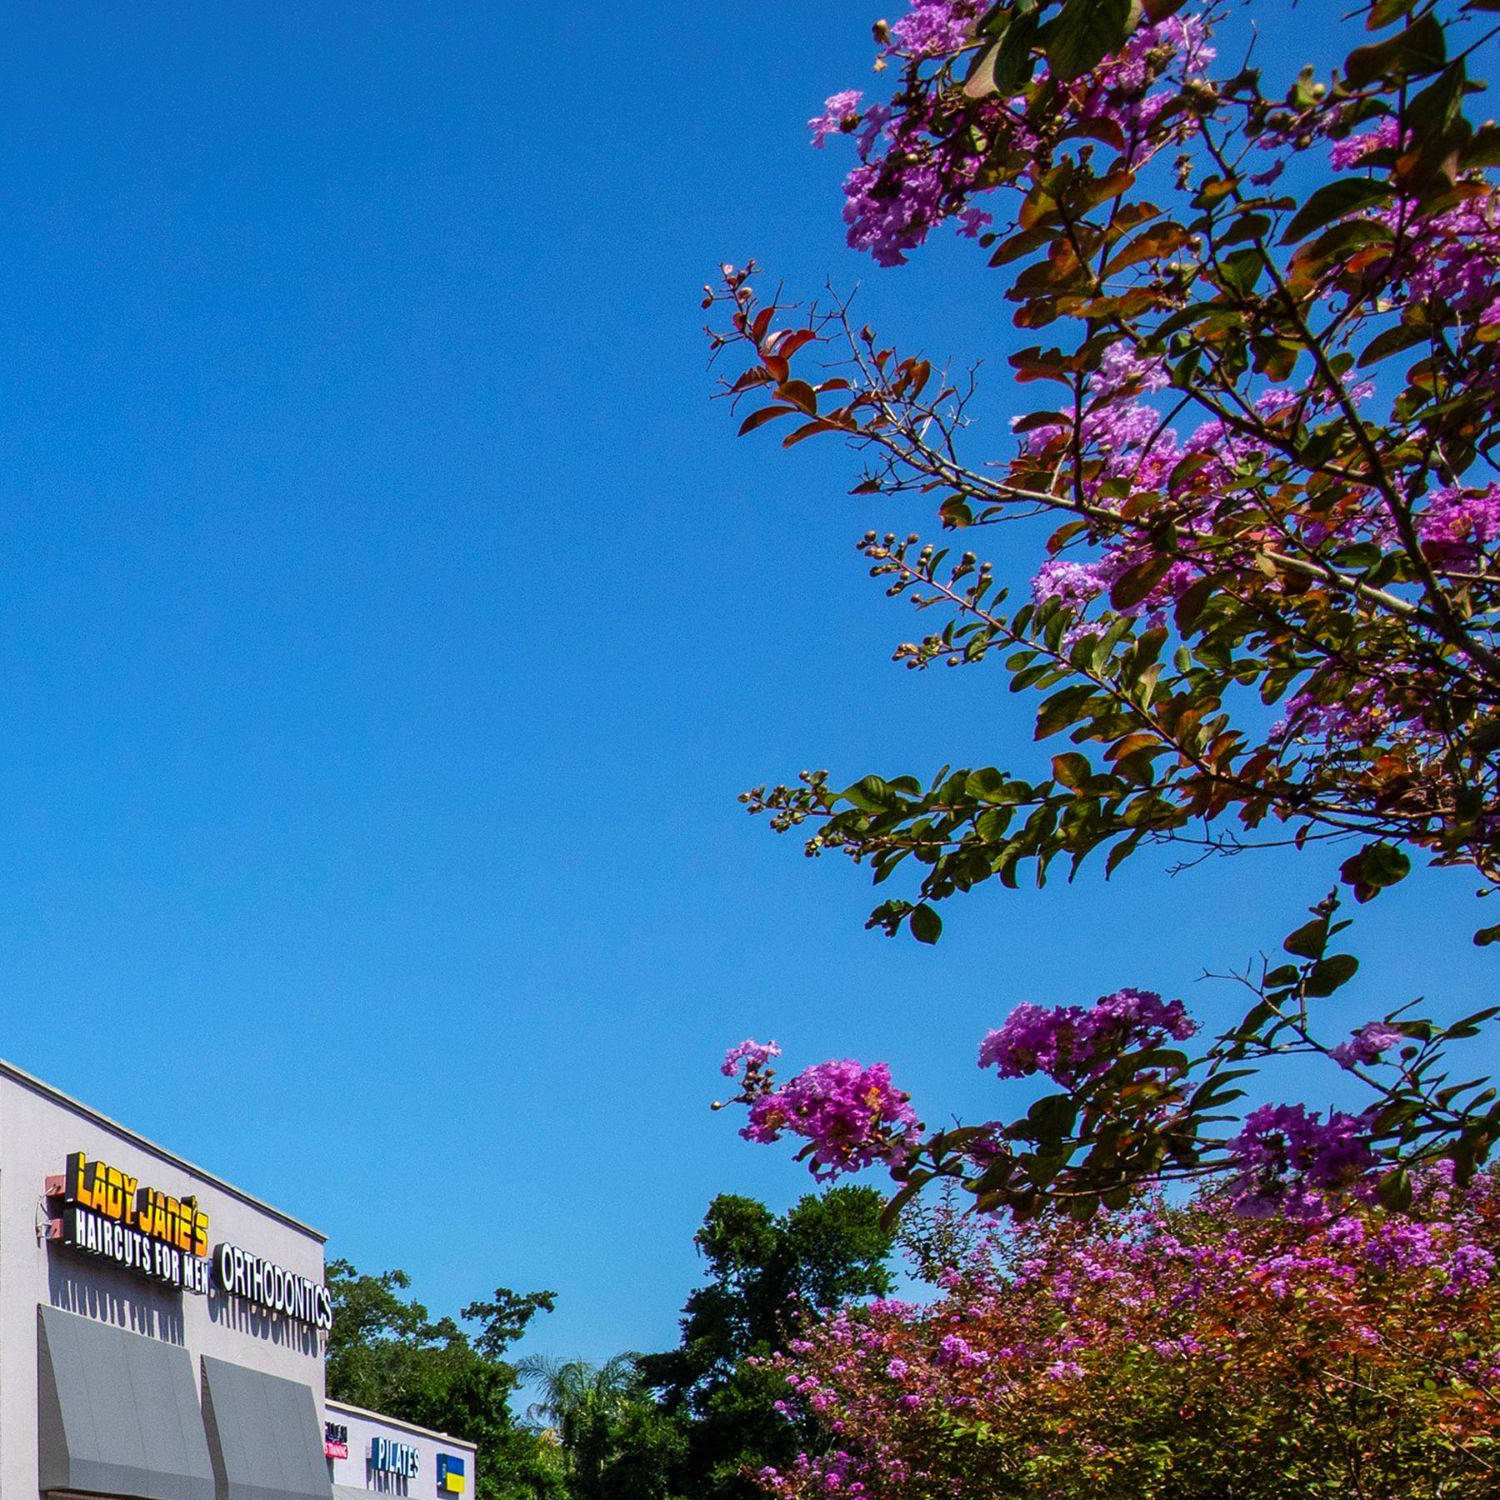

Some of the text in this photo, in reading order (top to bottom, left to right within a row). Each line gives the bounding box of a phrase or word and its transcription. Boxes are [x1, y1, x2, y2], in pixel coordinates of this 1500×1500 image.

[75, 1151, 209, 1258] LADY JANE'S
[75, 1207, 210, 1295] HAIRCUTS FOR MEN
[220, 1241, 333, 1331] ORTHODONTICS
[377, 1436, 420, 1478] PILATES
